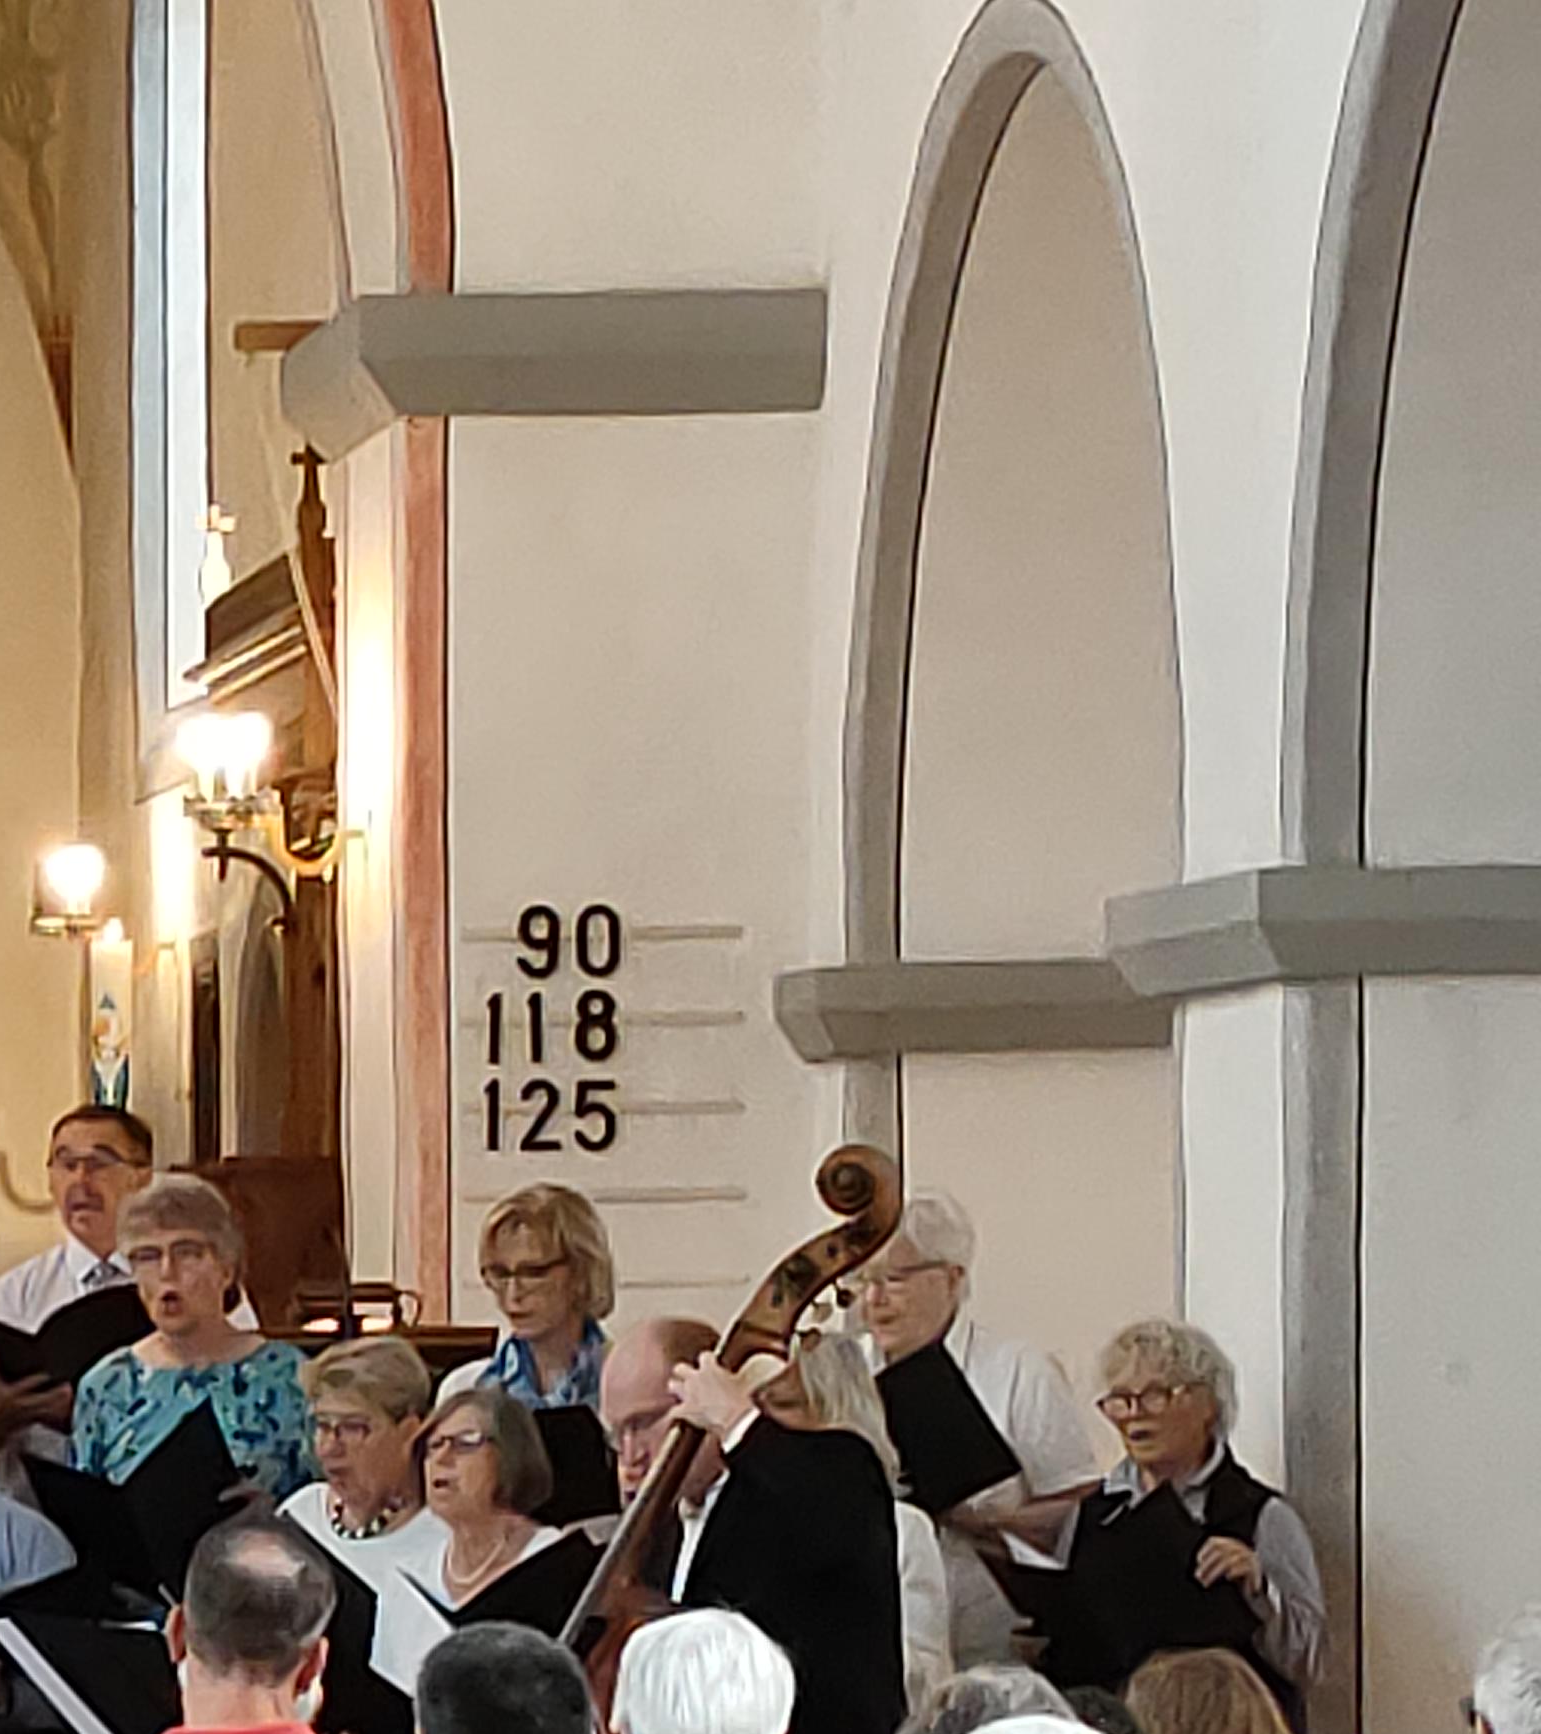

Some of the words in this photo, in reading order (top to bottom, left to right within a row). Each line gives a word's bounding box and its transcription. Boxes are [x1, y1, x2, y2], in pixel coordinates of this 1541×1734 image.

[517, 904, 621, 979] 90
[486, 989, 617, 1065] 118
[483, 1077, 617, 1152] 125
